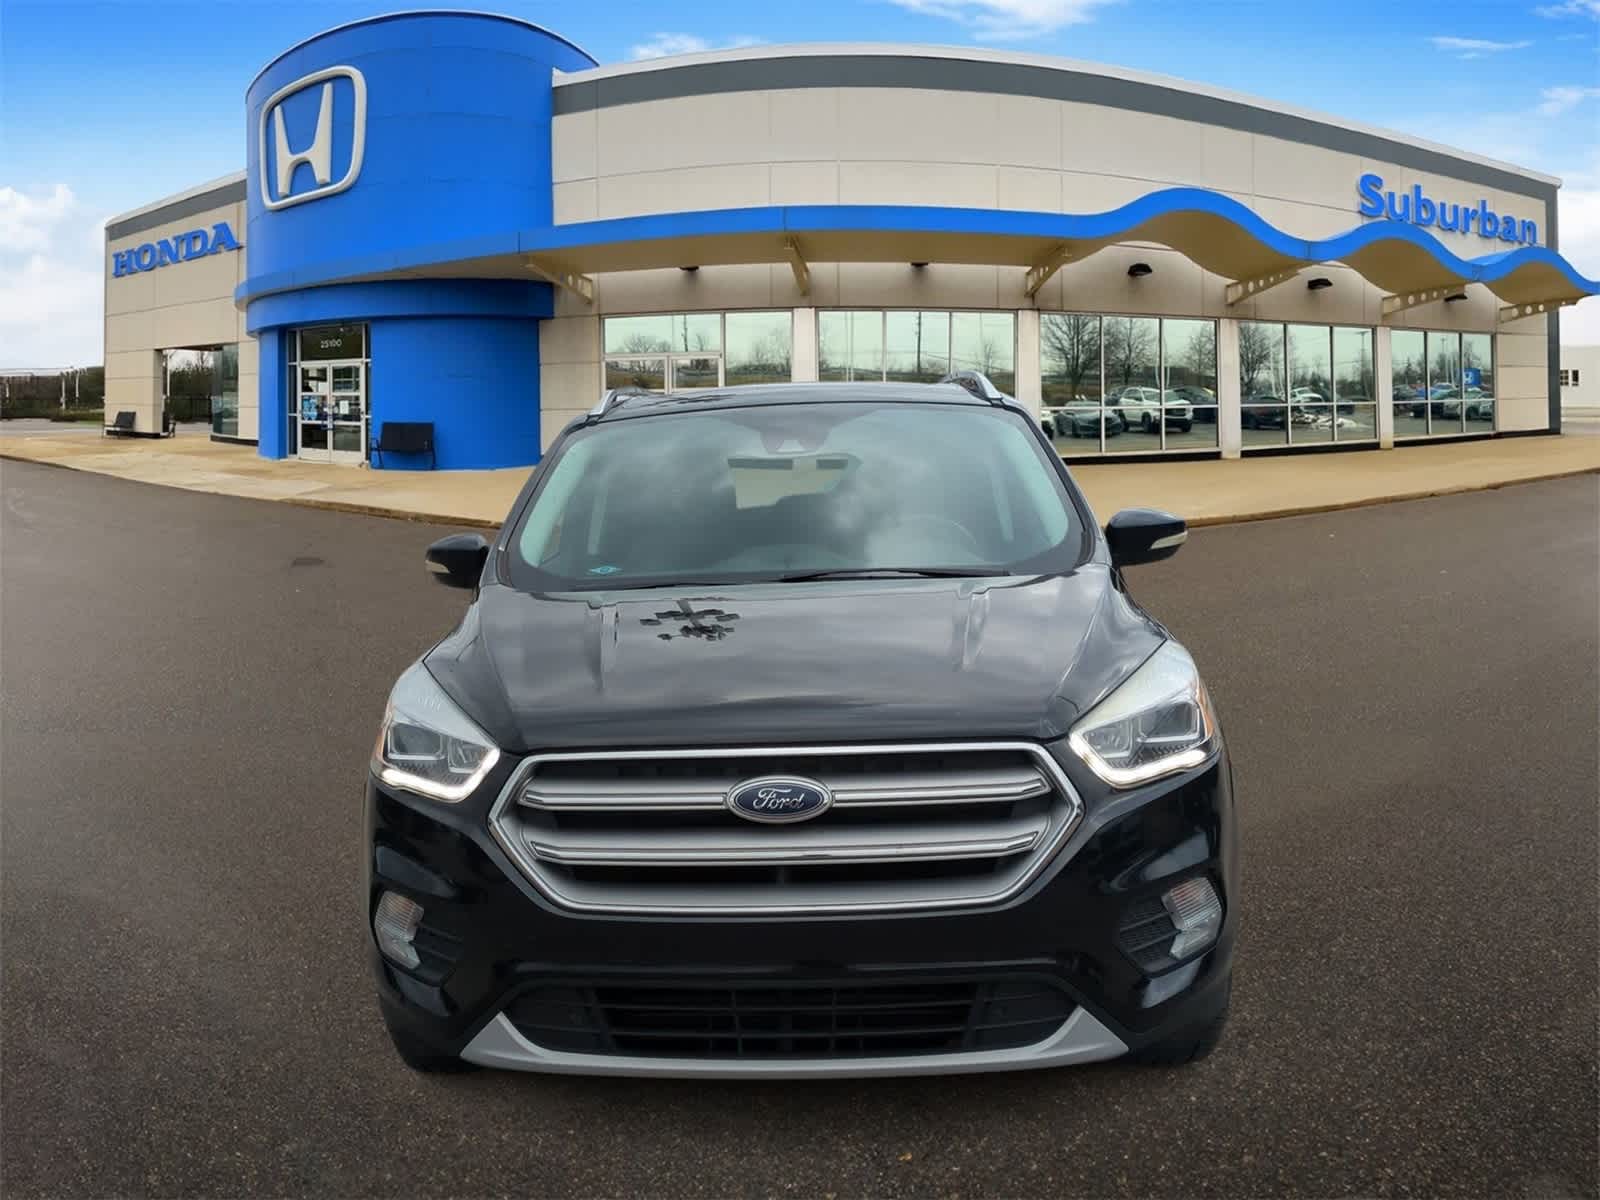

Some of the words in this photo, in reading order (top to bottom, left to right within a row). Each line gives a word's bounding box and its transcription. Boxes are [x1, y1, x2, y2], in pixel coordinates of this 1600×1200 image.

[1358, 173, 1537, 245] Suburban
[112, 221, 241, 277] HONDA
[752, 787, 805, 809] Ford
